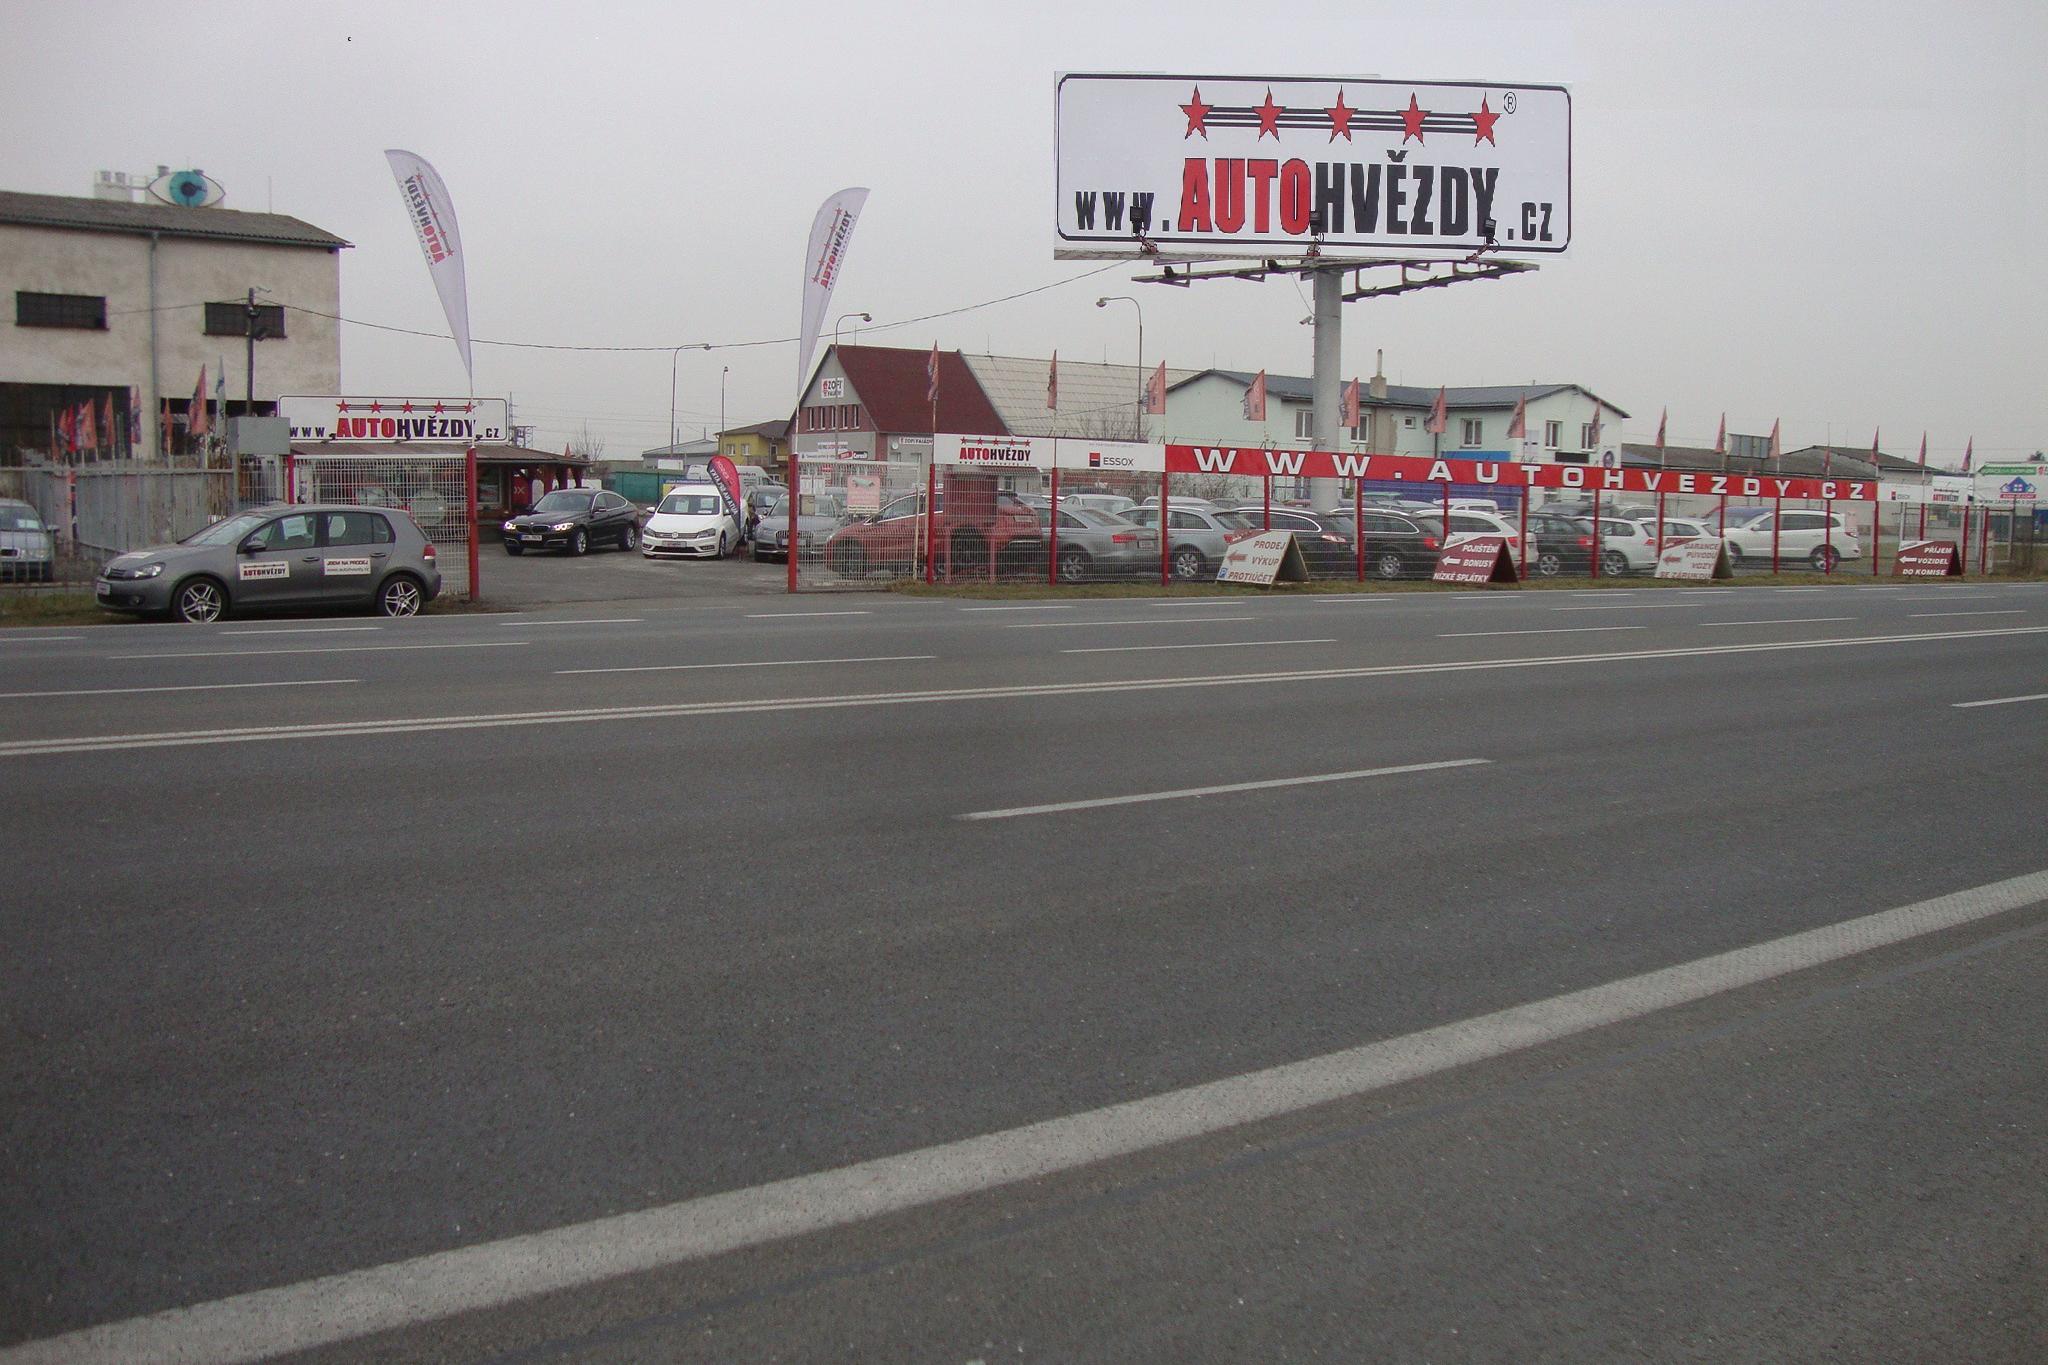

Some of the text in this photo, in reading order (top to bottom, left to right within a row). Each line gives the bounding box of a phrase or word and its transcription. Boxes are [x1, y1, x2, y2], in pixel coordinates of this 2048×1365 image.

[959, 446, 1031, 461] AUTOHVĚZDY
[1103, 457, 1134, 466] ESSOX
[1254, 540, 1286, 549] PRODEJ
[1252, 554, 1279, 565] VÝKUP
[1463, 559, 1493, 567] BONUSY
